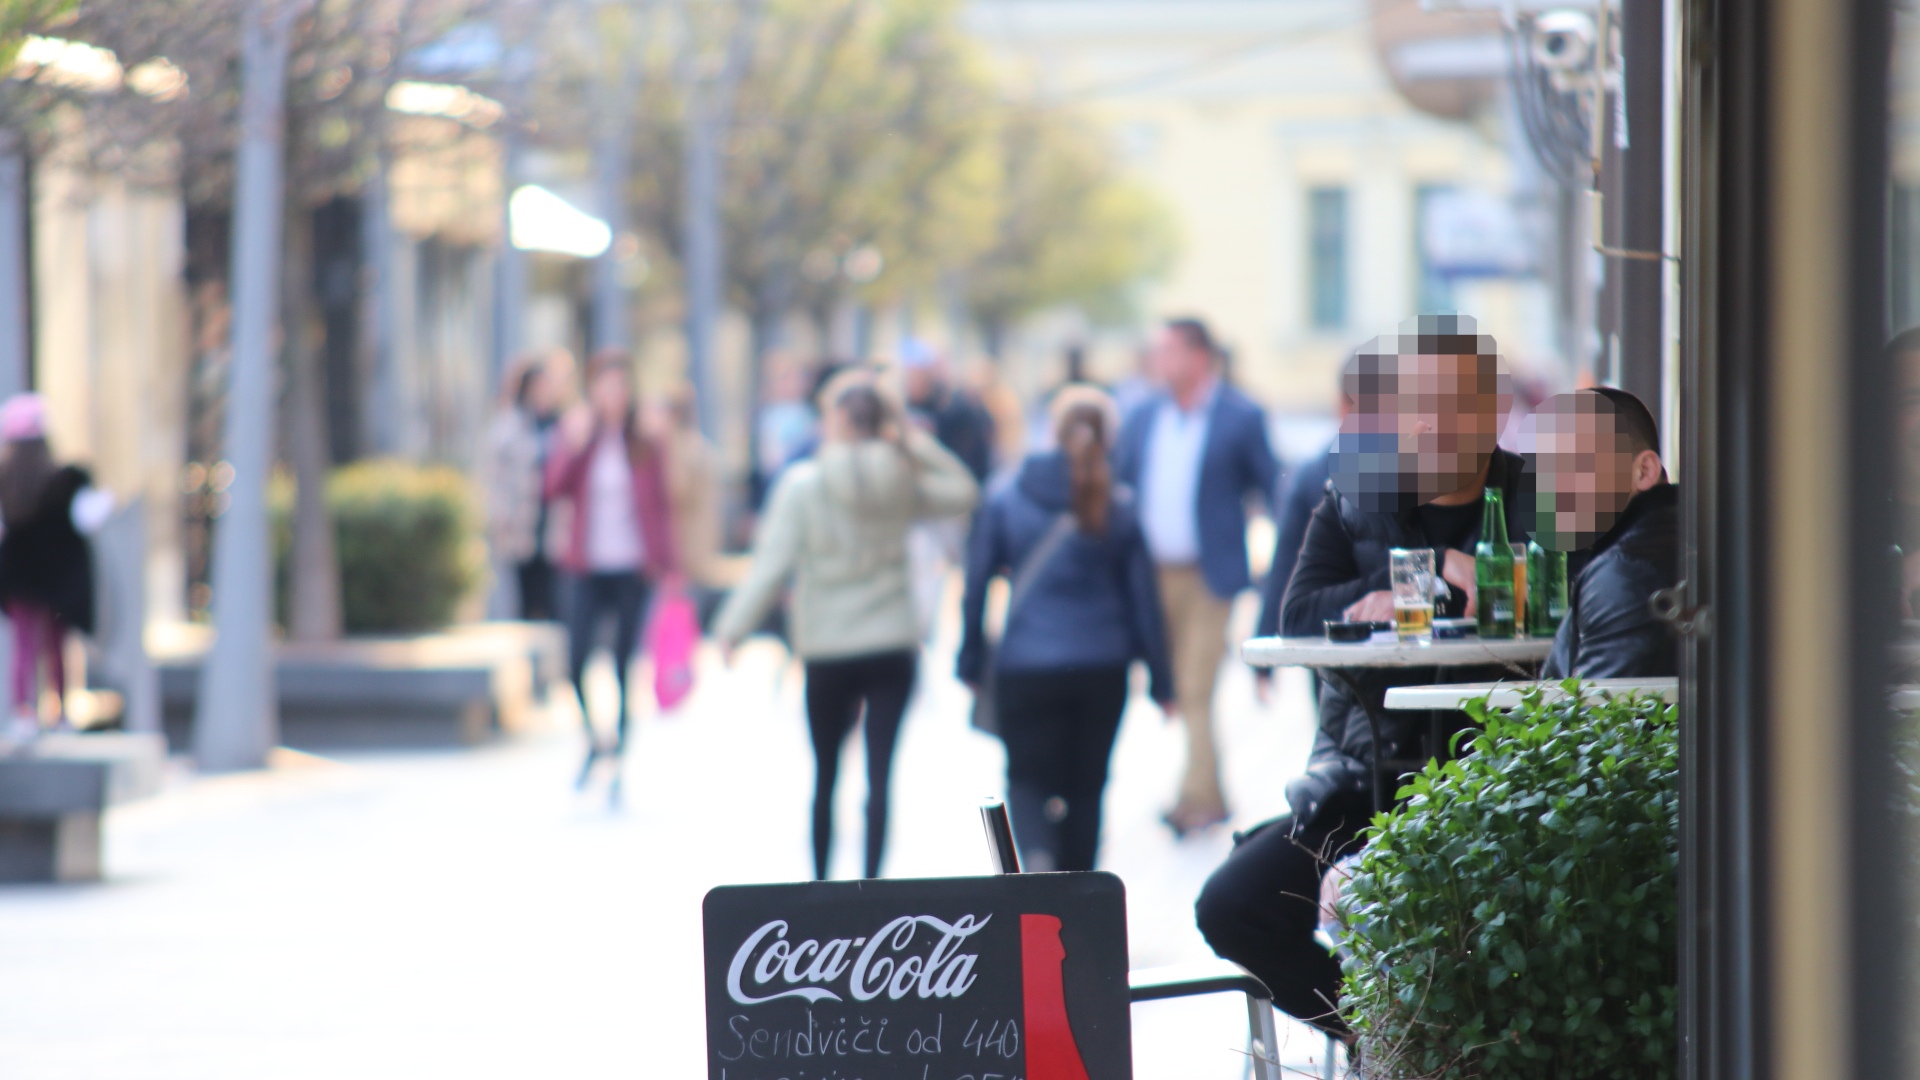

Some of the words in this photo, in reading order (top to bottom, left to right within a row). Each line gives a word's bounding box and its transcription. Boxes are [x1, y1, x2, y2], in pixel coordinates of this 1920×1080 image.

[727, 913, 993, 1004] Coca-Cola
[906, 1012, 942, 1054] od
[962, 1018, 1019, 1058] 440
